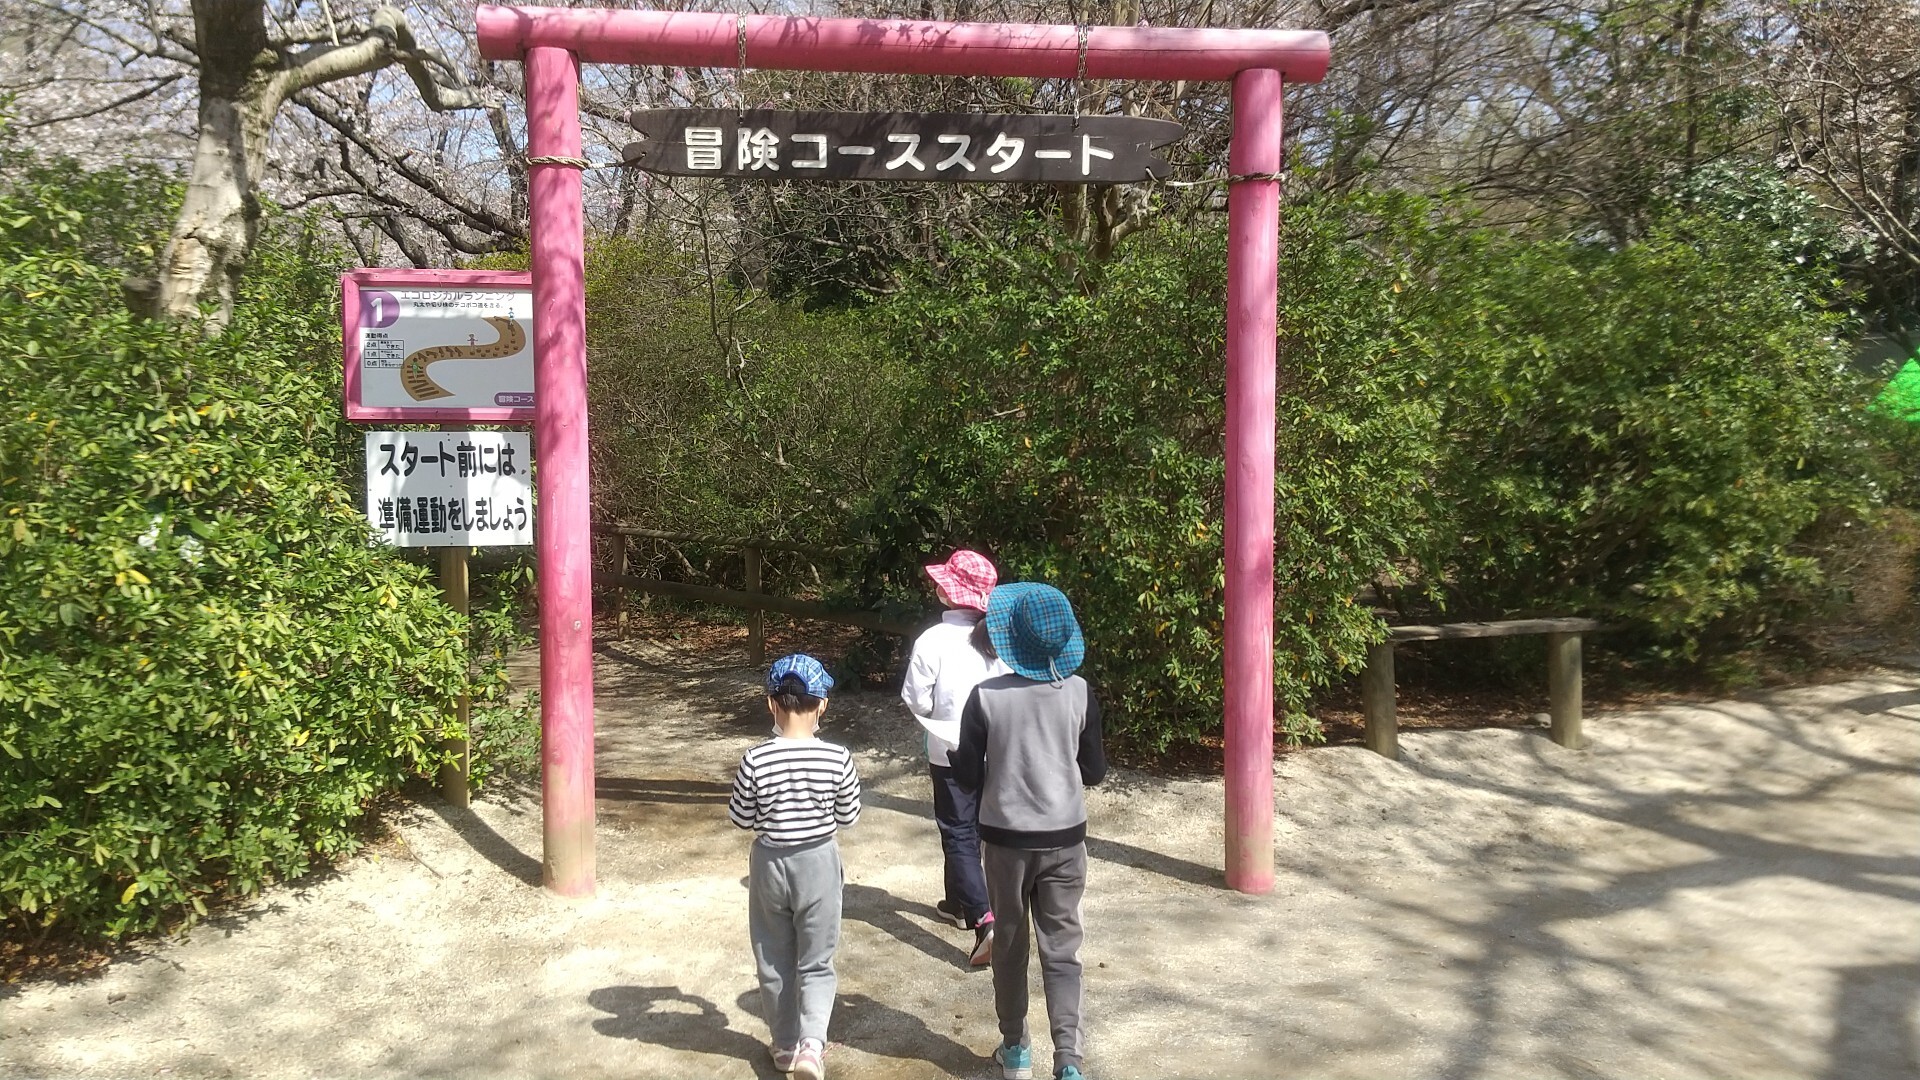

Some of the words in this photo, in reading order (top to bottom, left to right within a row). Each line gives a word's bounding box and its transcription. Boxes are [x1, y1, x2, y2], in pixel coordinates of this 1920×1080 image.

[684, 126, 1115, 176] 冒険コーススタート
[370, 297, 383, 322] 1
[378, 496, 527, 534] 準備運動をしましょう
